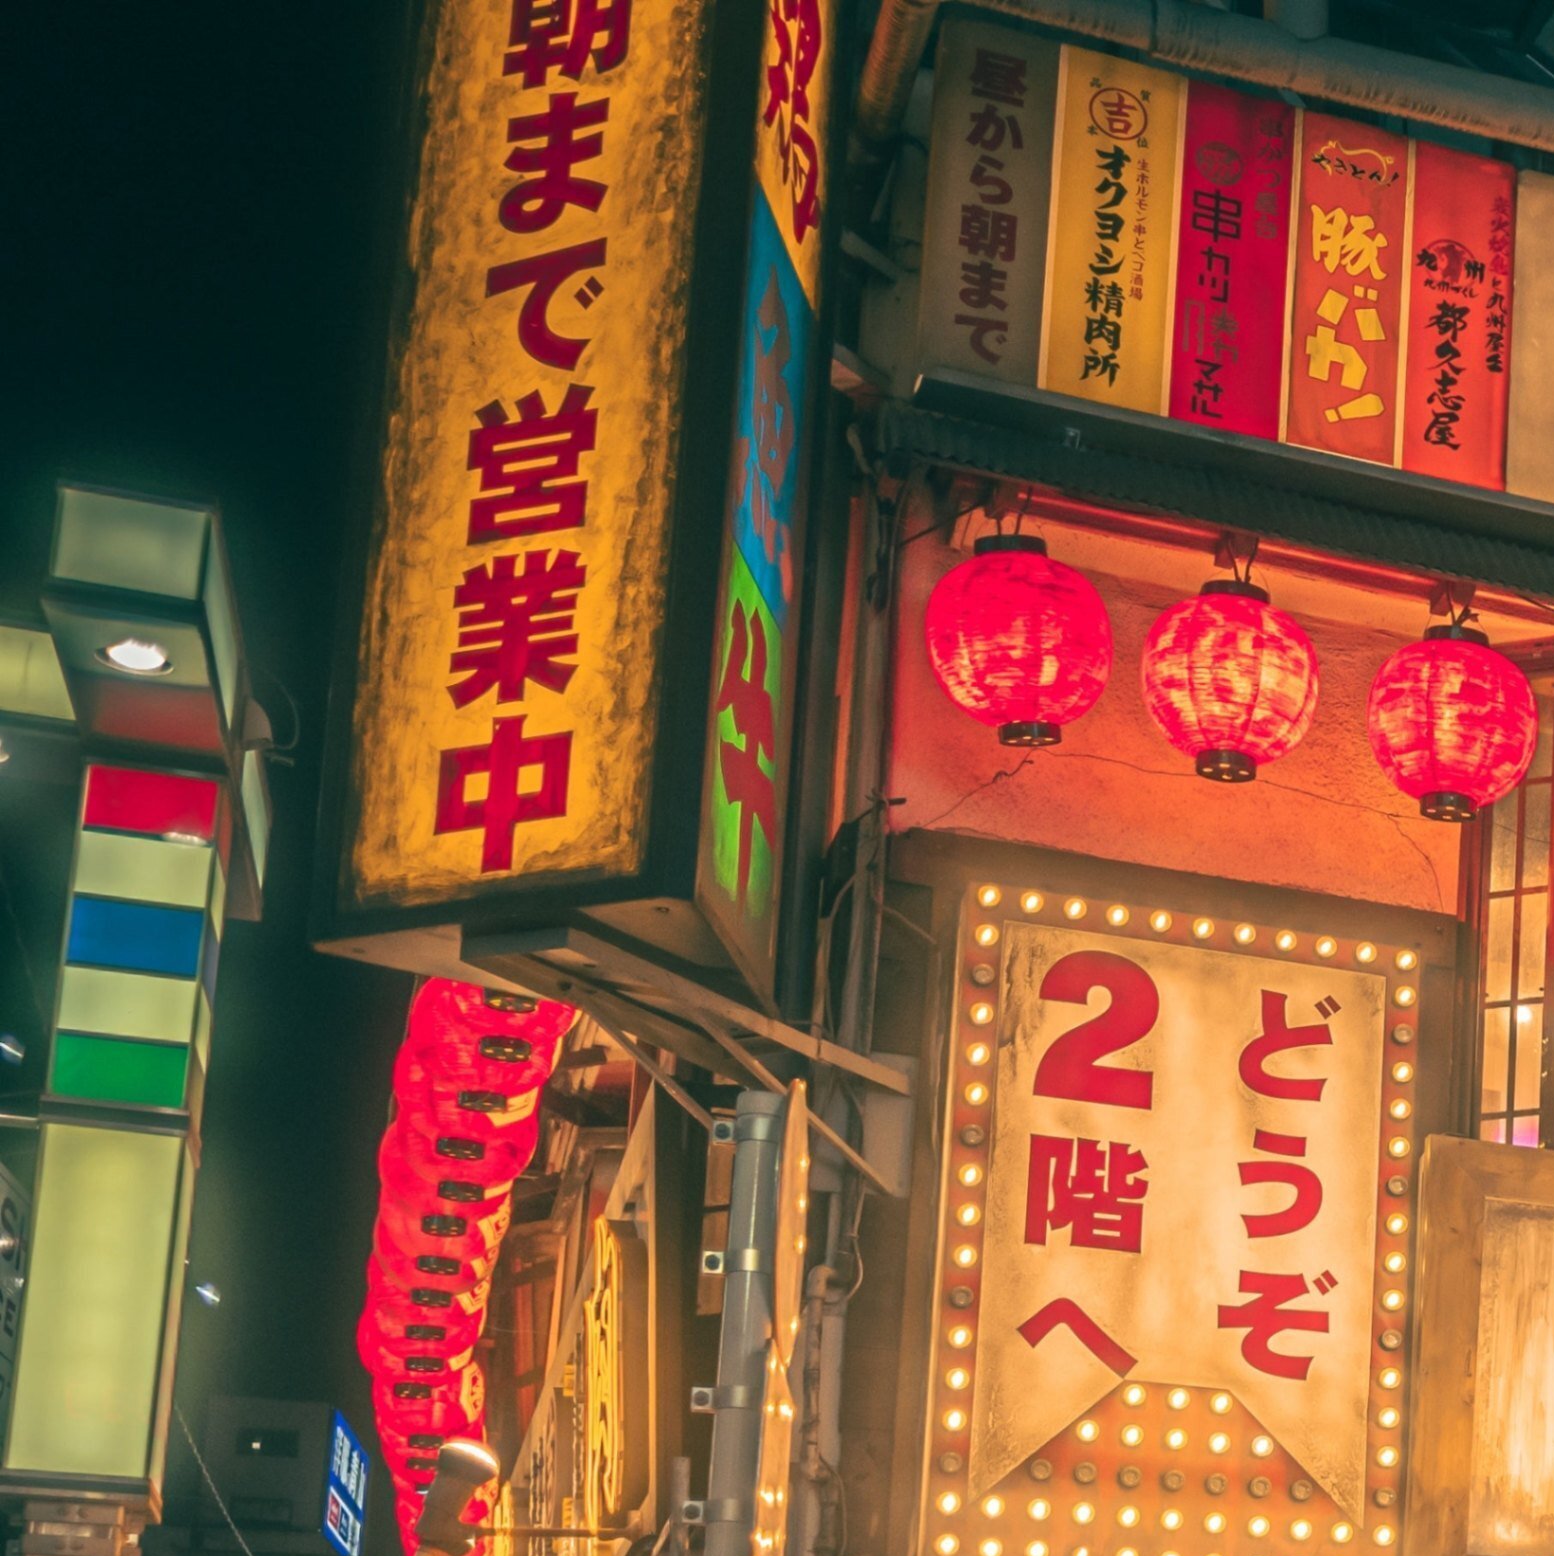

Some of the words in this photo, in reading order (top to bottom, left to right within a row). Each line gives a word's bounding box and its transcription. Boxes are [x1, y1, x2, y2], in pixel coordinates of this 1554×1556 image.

[953, 47, 1027, 366] 昼から朝まで
[1079, 144, 1133, 389] オクヨシ精肉所
[1100, 93, 1137, 136] 吉
[1016, 950, 1161, 1381] 2階へ
[1216, 989, 1337, 1383] どうぞ
